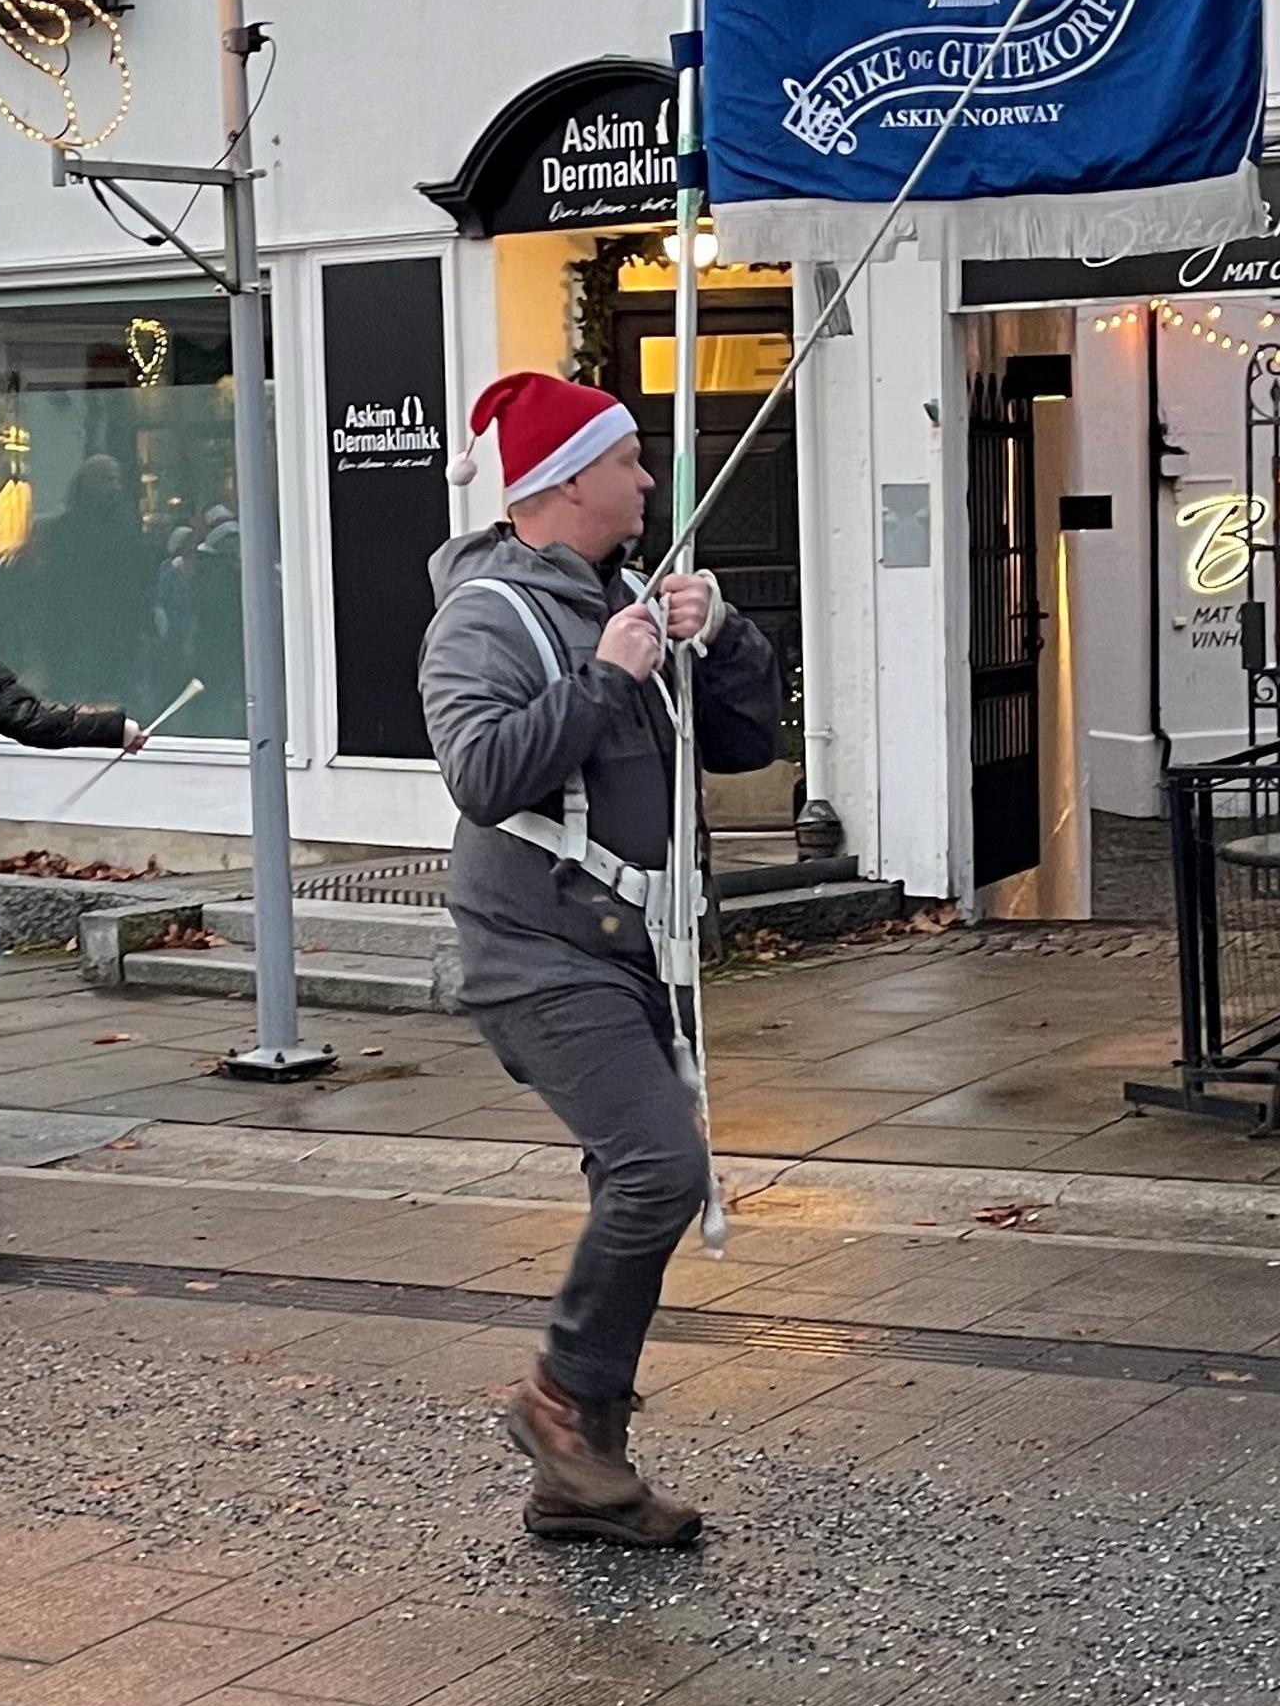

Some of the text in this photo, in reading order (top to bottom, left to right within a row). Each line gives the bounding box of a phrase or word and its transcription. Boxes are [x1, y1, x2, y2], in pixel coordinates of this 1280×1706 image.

[824, 46, 907, 109] PIKE
[909, 49, 933, 70] OG
[879, 104, 1064, 128] ASKIM NORWAY
[562, 113, 644, 154] Askim
[543, 148, 677, 193] Dermaklin
[1222, 261, 1269, 282] MAT
[345, 403, 396, 428] Askim
[333, 426, 441, 453] Dermaklinikk
[1192, 605, 1236, 625] MAT
[1192, 630, 1242, 649] VINH
